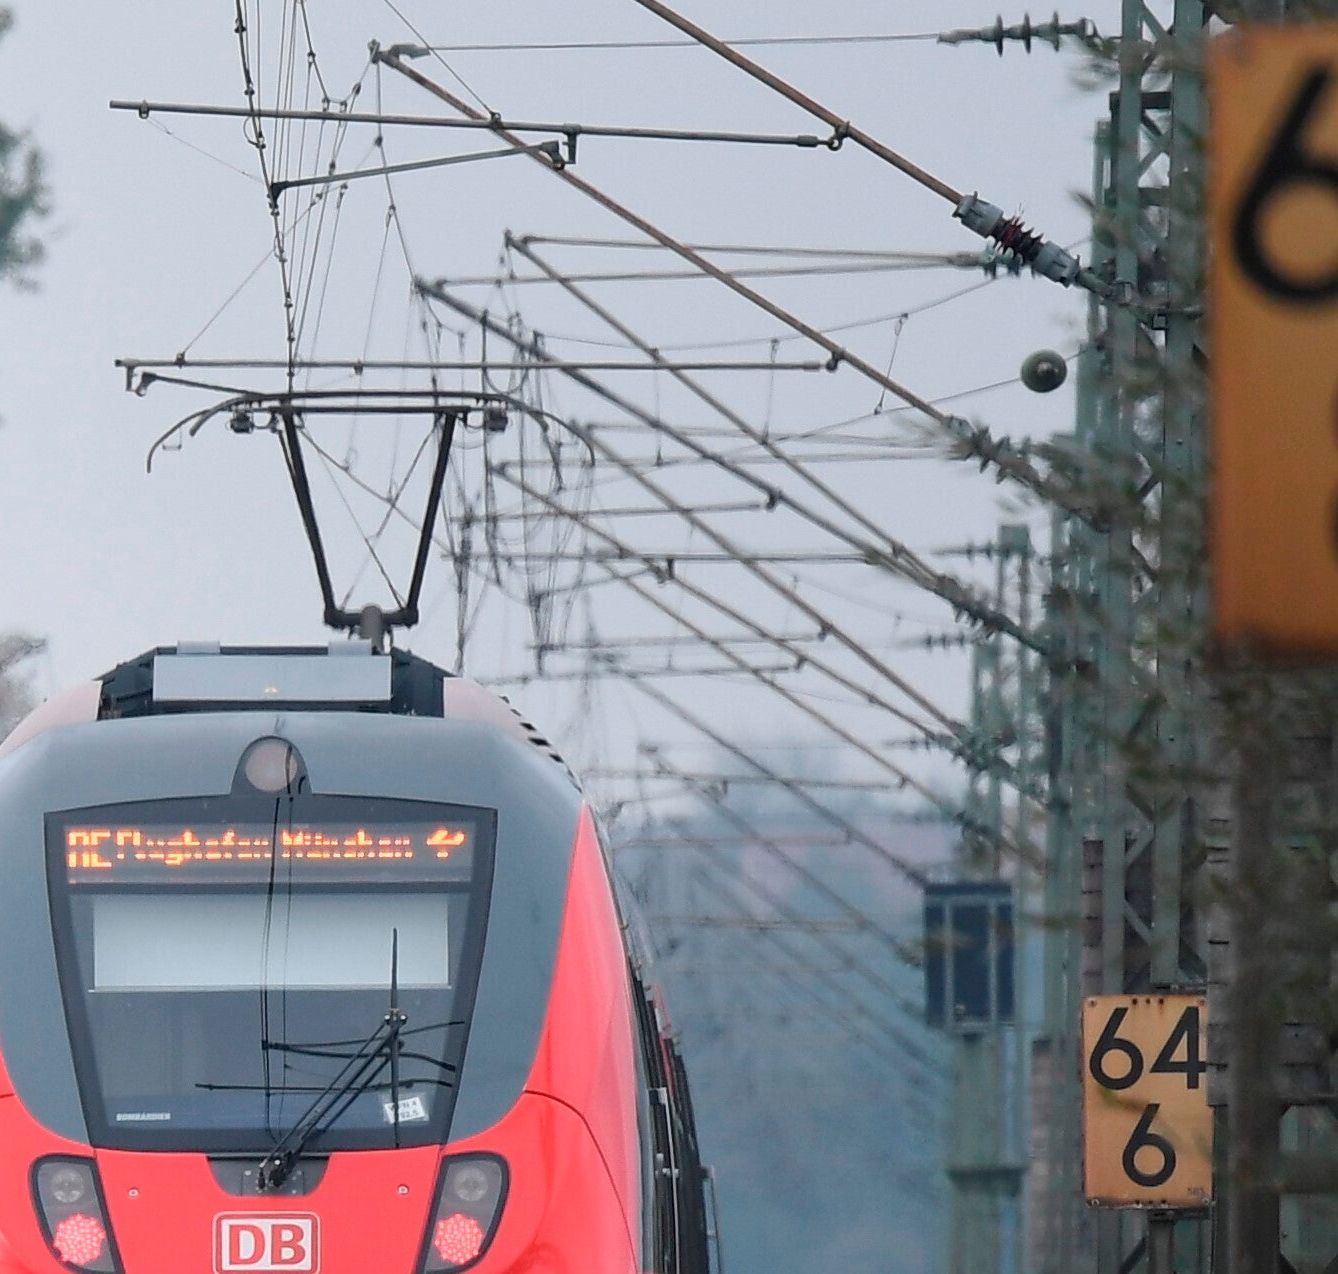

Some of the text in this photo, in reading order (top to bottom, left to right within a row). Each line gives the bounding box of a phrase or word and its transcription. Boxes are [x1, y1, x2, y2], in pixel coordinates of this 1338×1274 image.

[68, 831, 112, 868] RE
[116, 831, 272, 866] Flughafen
[1089, 1006, 1206, 1090] 64
[1122, 1103, 1176, 1187] 6
[229, 1224, 306, 1266] DB
